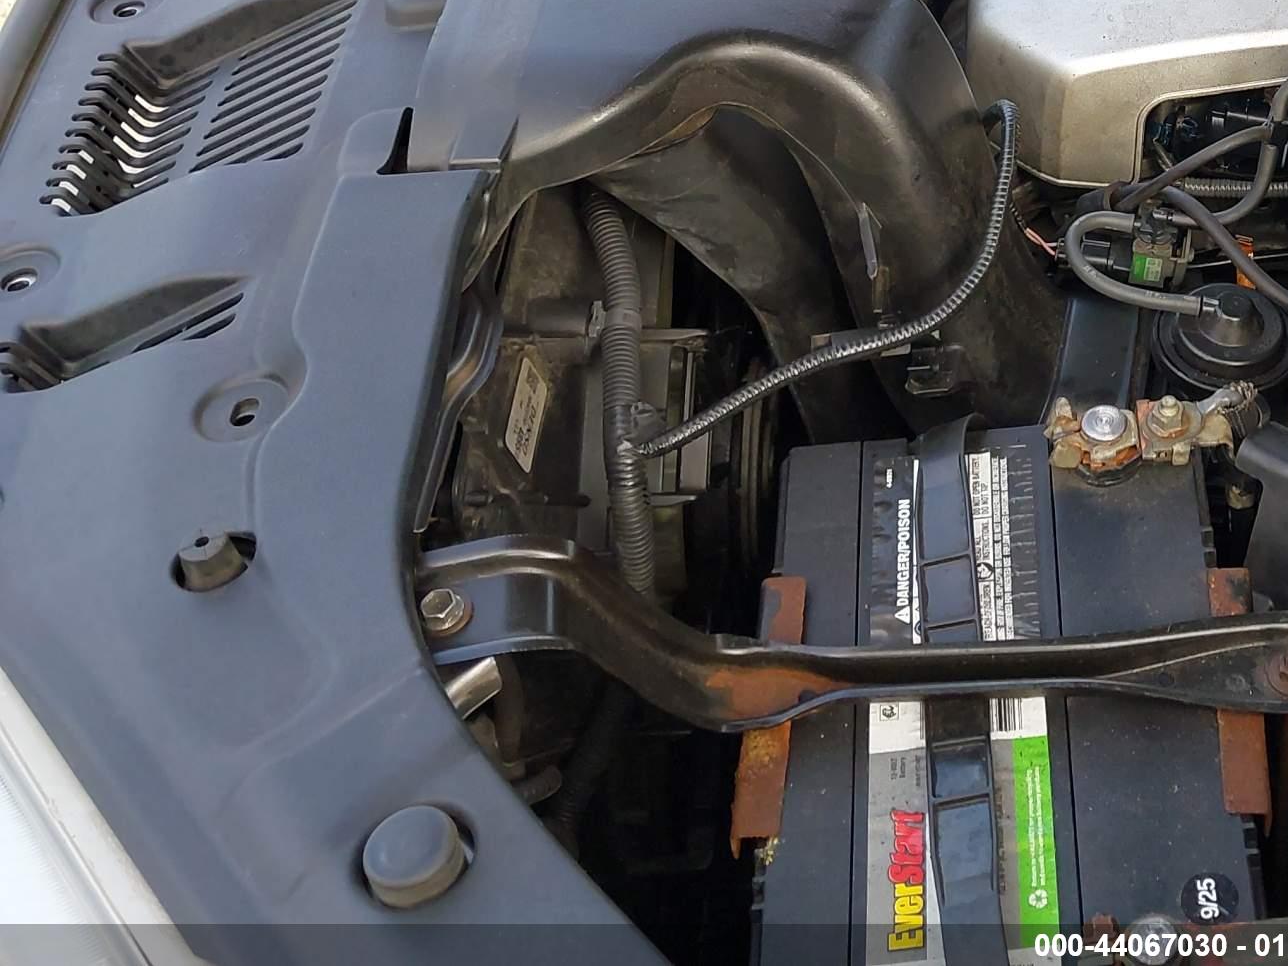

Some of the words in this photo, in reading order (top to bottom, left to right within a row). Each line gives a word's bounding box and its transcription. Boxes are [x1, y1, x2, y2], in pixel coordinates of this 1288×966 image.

[896, 499, 912, 607] DANGER/POISON
[887, 809, 926, 952] EverStart
[1197, 877, 1219, 920] 9/25
